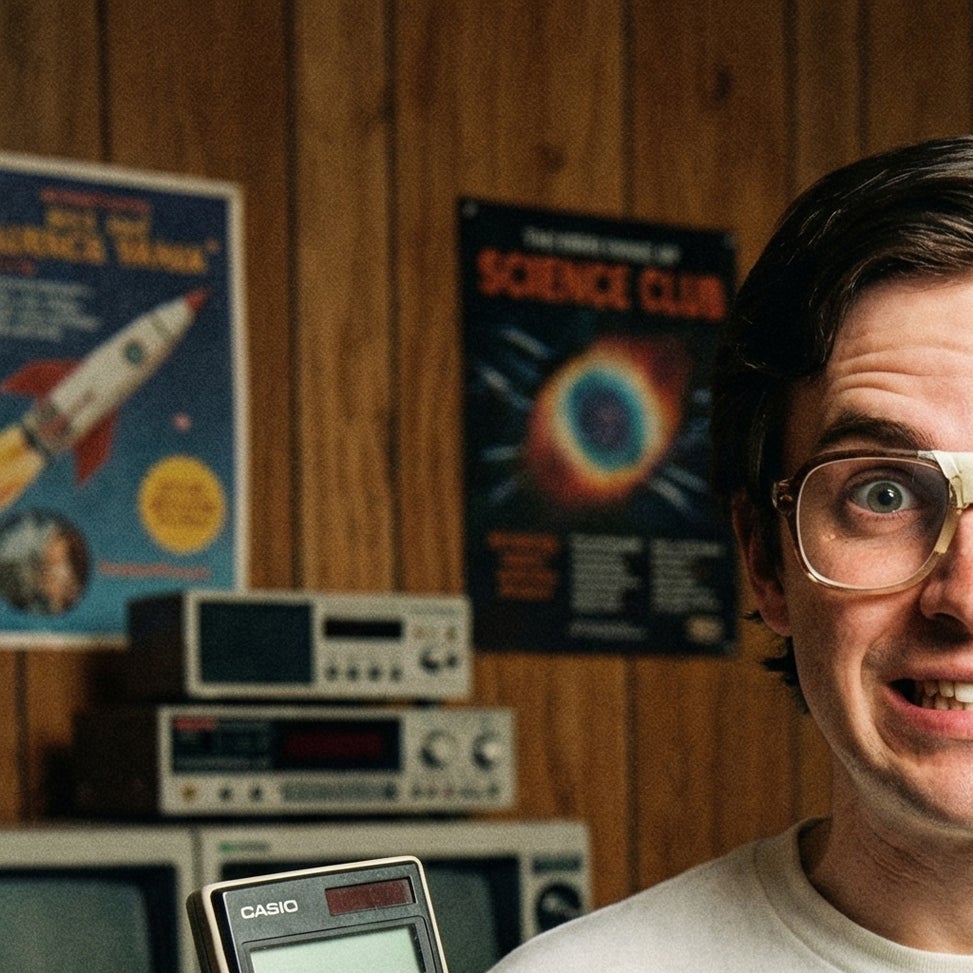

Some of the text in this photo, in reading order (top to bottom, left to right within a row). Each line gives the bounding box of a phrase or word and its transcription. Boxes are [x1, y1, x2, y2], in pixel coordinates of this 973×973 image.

[477, 248, 630, 311] SCIENCE
[640, 268, 727, 323] CLUB
[240, 900, 299, 919] CASIO
